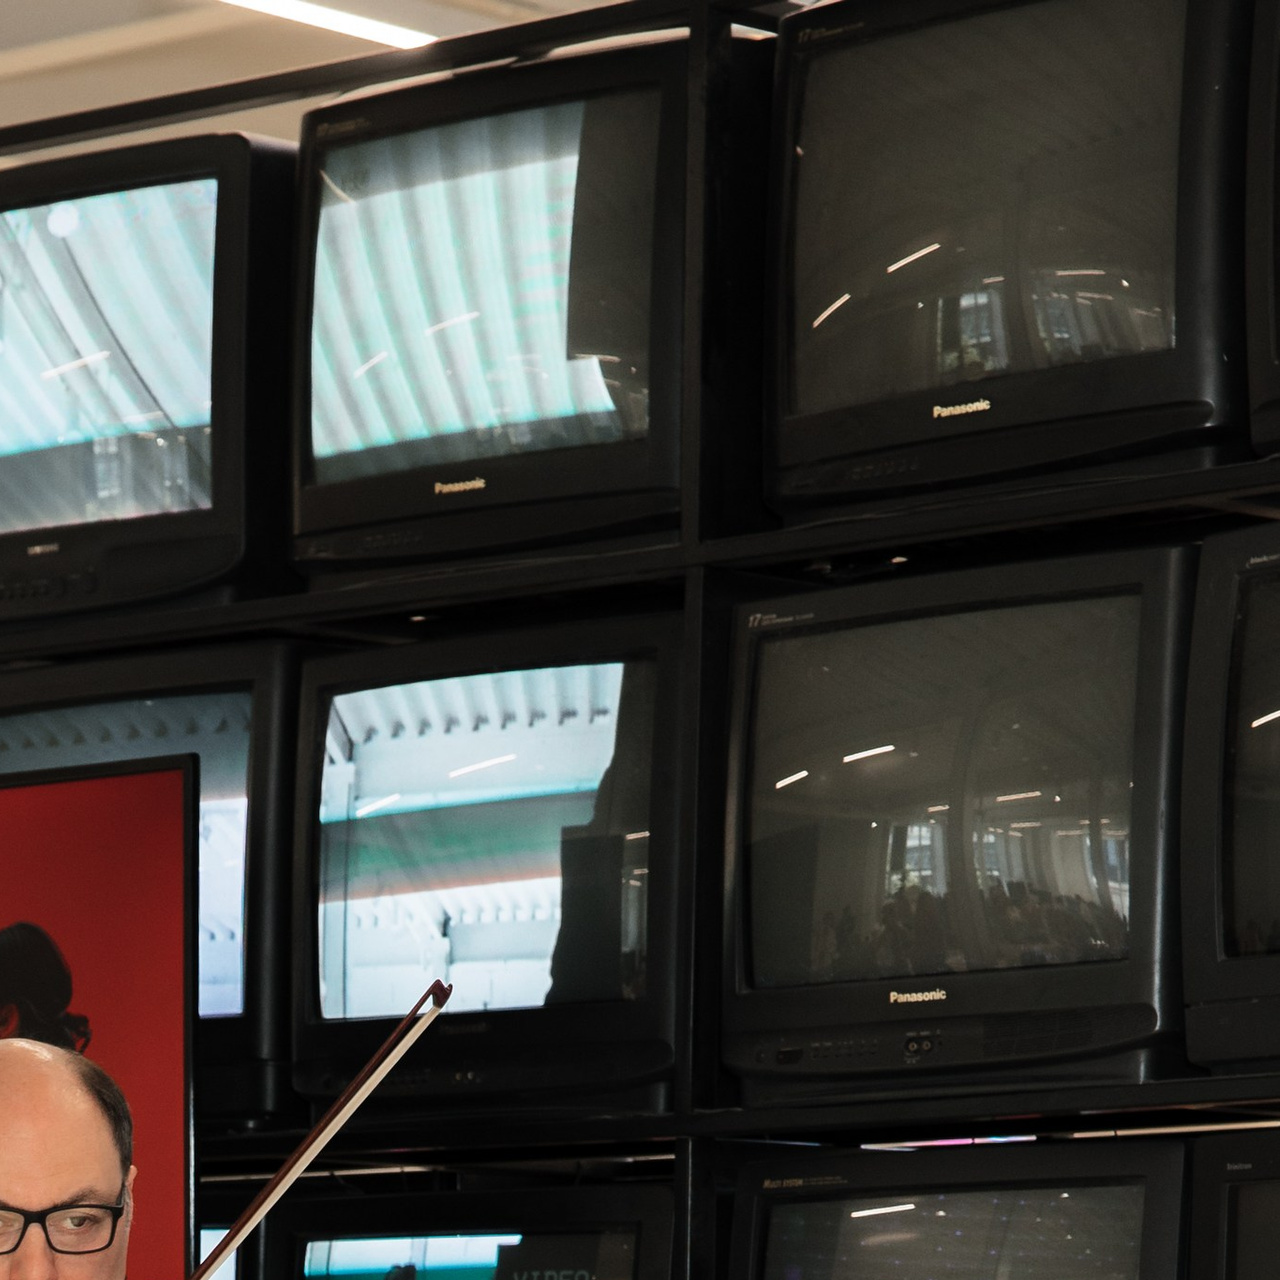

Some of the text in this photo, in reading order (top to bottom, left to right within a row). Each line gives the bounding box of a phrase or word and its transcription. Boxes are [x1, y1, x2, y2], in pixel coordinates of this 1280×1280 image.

[932, 398, 991, 418] Panasonic
[434, 477, 486, 494] Panasonic
[890, 988, 947, 1003] Panasonic
